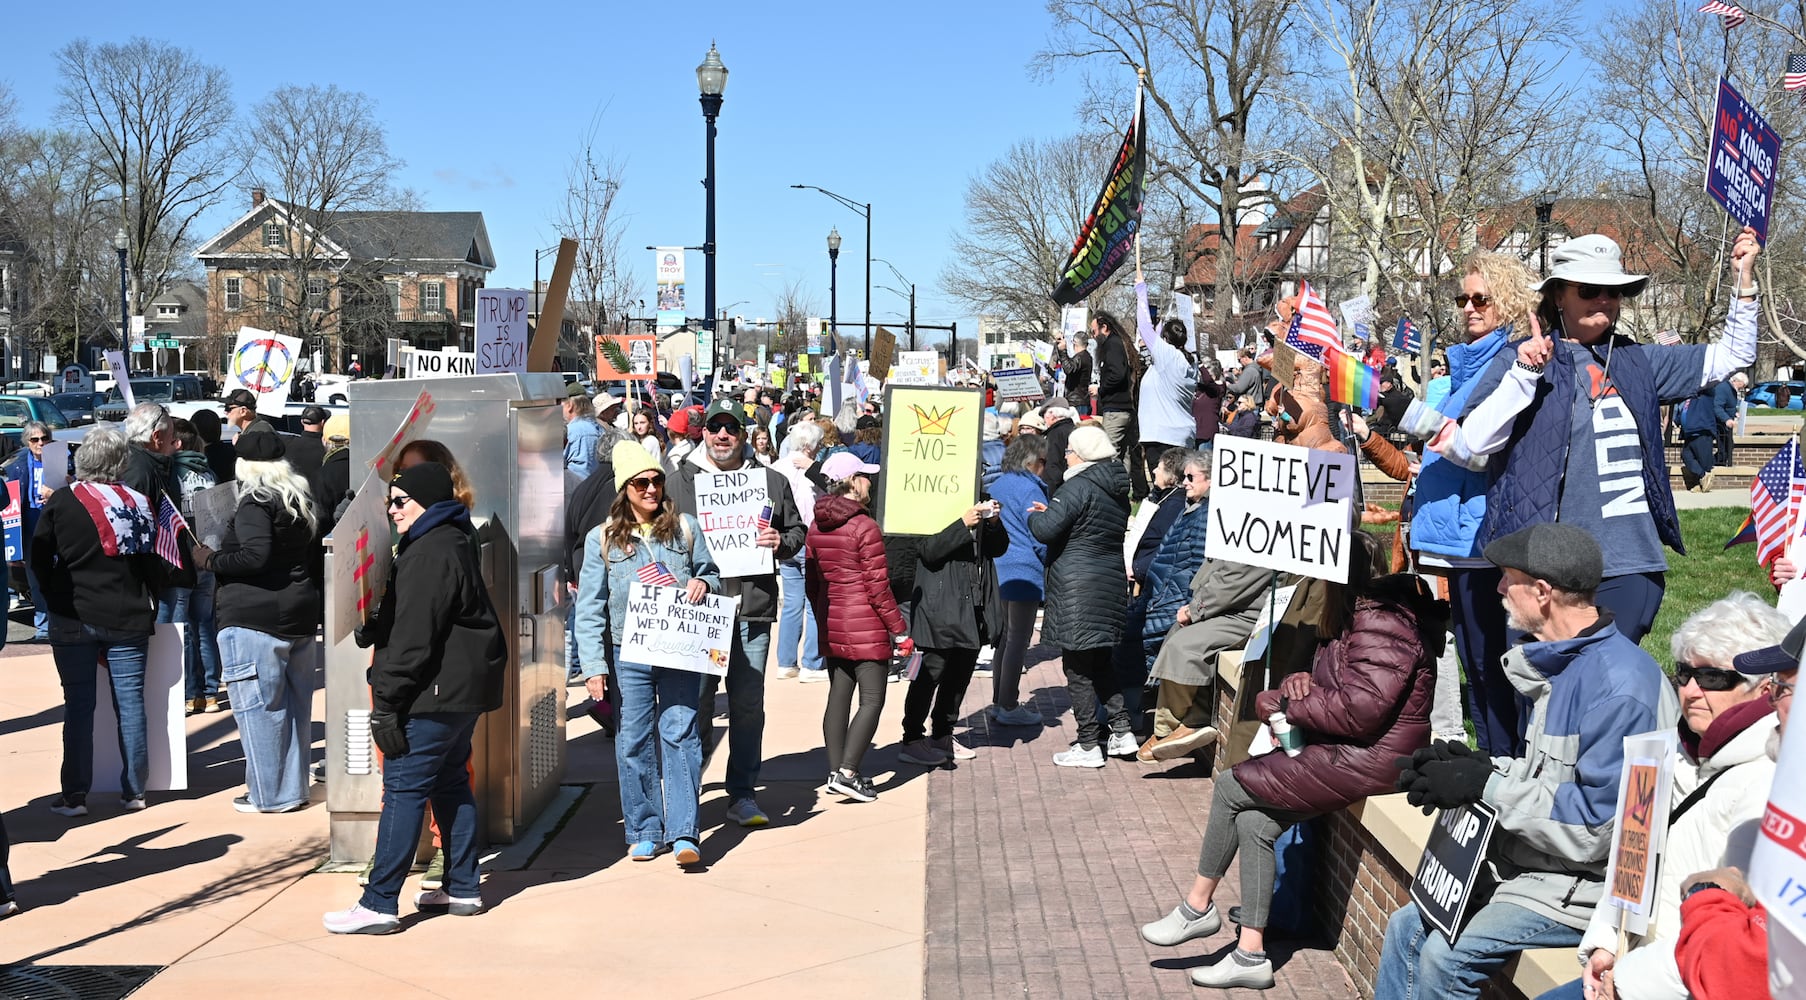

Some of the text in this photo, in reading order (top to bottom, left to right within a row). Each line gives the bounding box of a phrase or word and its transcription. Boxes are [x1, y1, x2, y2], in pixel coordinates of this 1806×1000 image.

[1720, 108, 1773, 180] NO KINGS
[1741, 156, 1749, 172] IN
[1714, 149, 1766, 217] AMERICA
[480, 296, 525, 324] TRUMP
[496, 324, 510, 341] IS
[418, 355, 441, 373] NO
[481, 341, 524, 369] SICK!
[713, 472, 749, 488] END
[903, 473, 960, 495] KINGS
[1218, 448, 1341, 503] BELIEVE
[698, 487, 766, 507] TRUMP'S
[699, 512, 762, 532] ILLEGA
[1216, 508, 1342, 567] WOMEN
[641, 585, 720, 609] IF KALA
[629, 601, 730, 628] WAS PRESIDENT,
[629, 632, 647, 646] AT
[636, 616, 722, 639] WE'D ALL BE
[1417, 848, 1464, 913] TRUMP
